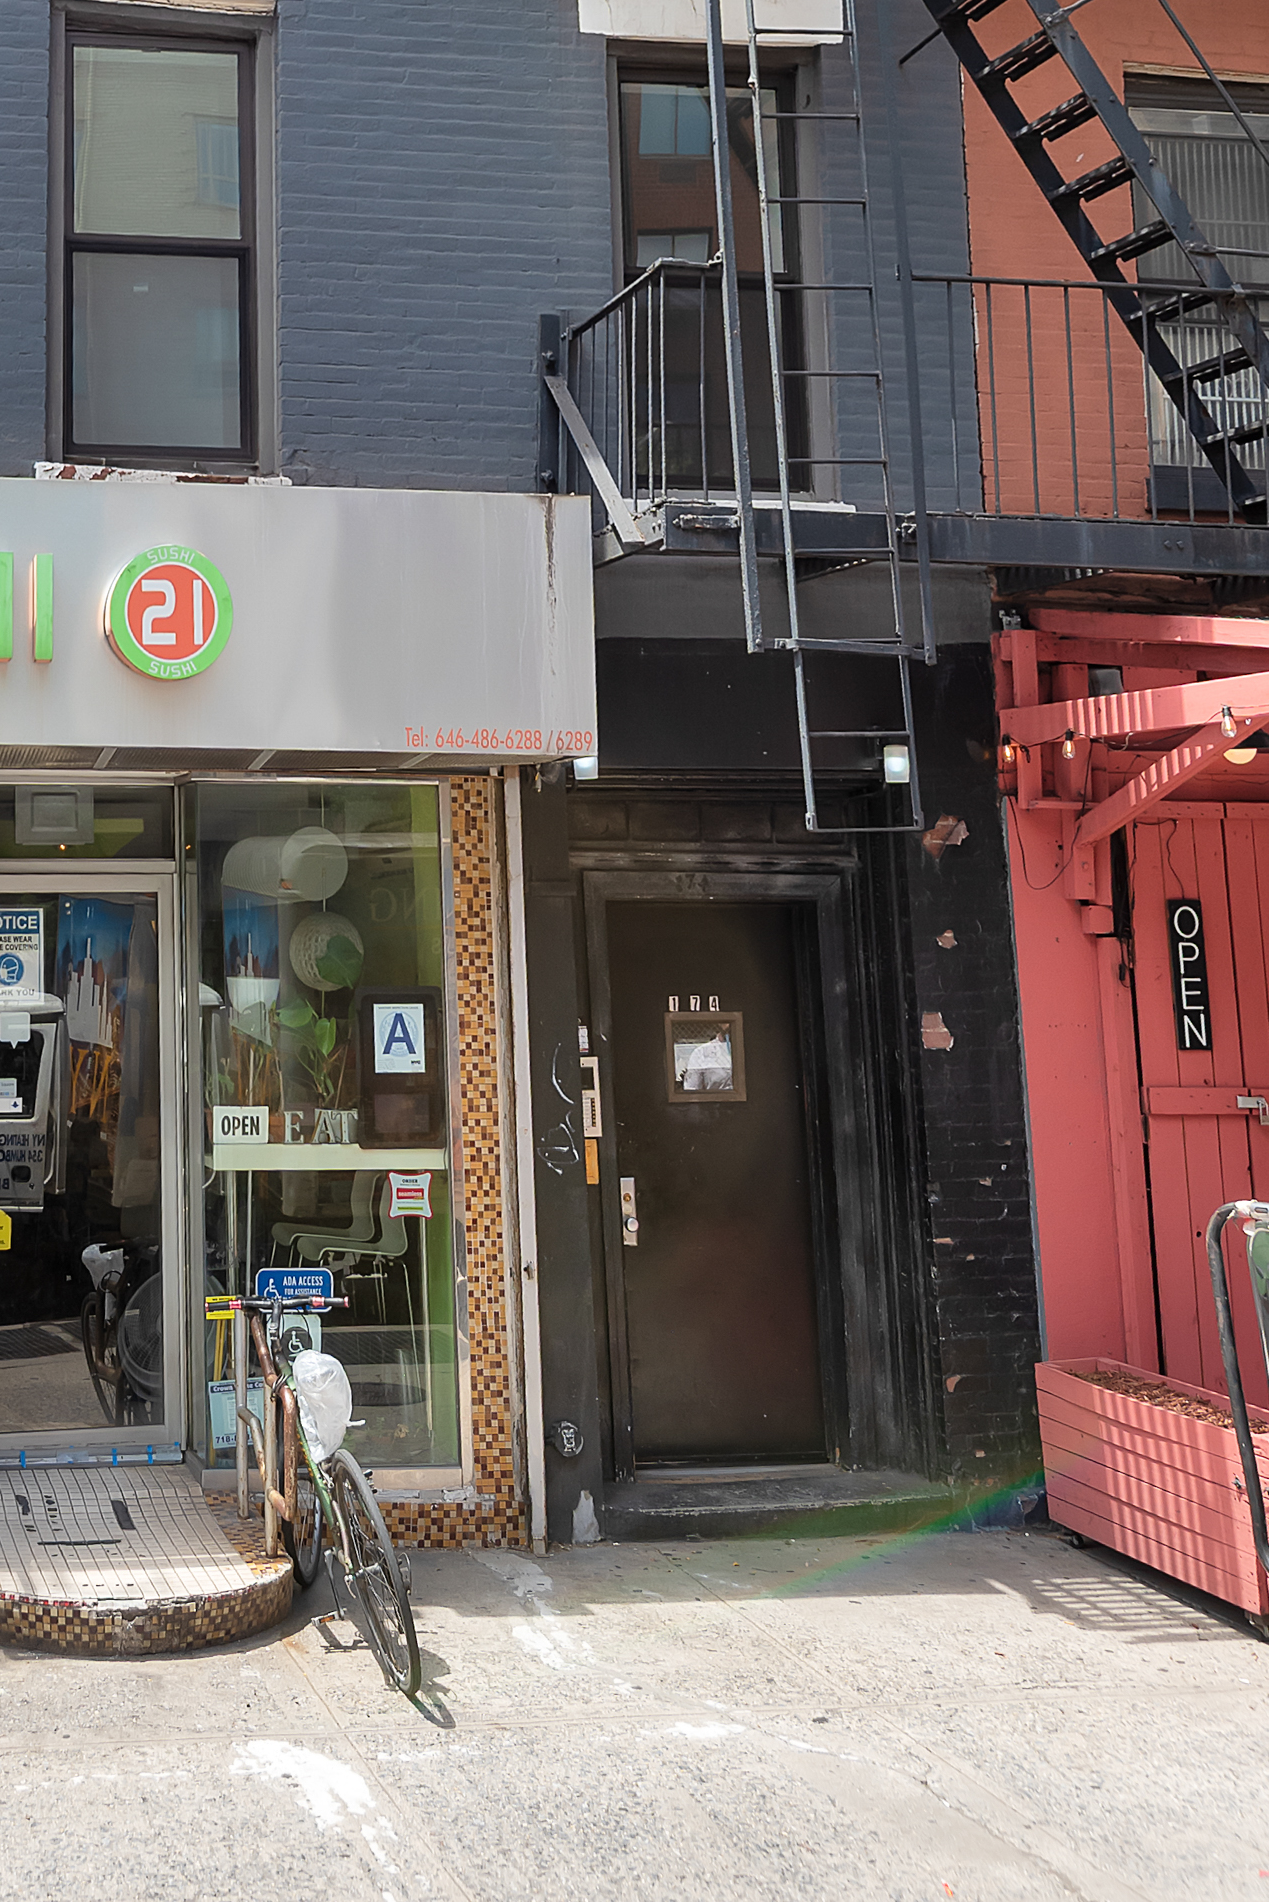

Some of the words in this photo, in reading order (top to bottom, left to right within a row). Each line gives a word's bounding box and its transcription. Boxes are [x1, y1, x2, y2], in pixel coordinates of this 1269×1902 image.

[147, 547, 195, 564] SUSHI
[141, 579, 204, 645] 21
[148, 660, 197, 677] SUSHI
[405, 726, 429, 747] Tel:
[435, 726, 543, 750] 646-486-6288
[1173, 906, 1207, 1048] OPEN
[382, 1012, 417, 1055] A
[221, 1115, 260, 1136] OPEN
[283, 1108, 359, 1144] EAT
[282, 1276, 297, 1287] ADA
[298, 1275, 324, 1286] ACCESS
